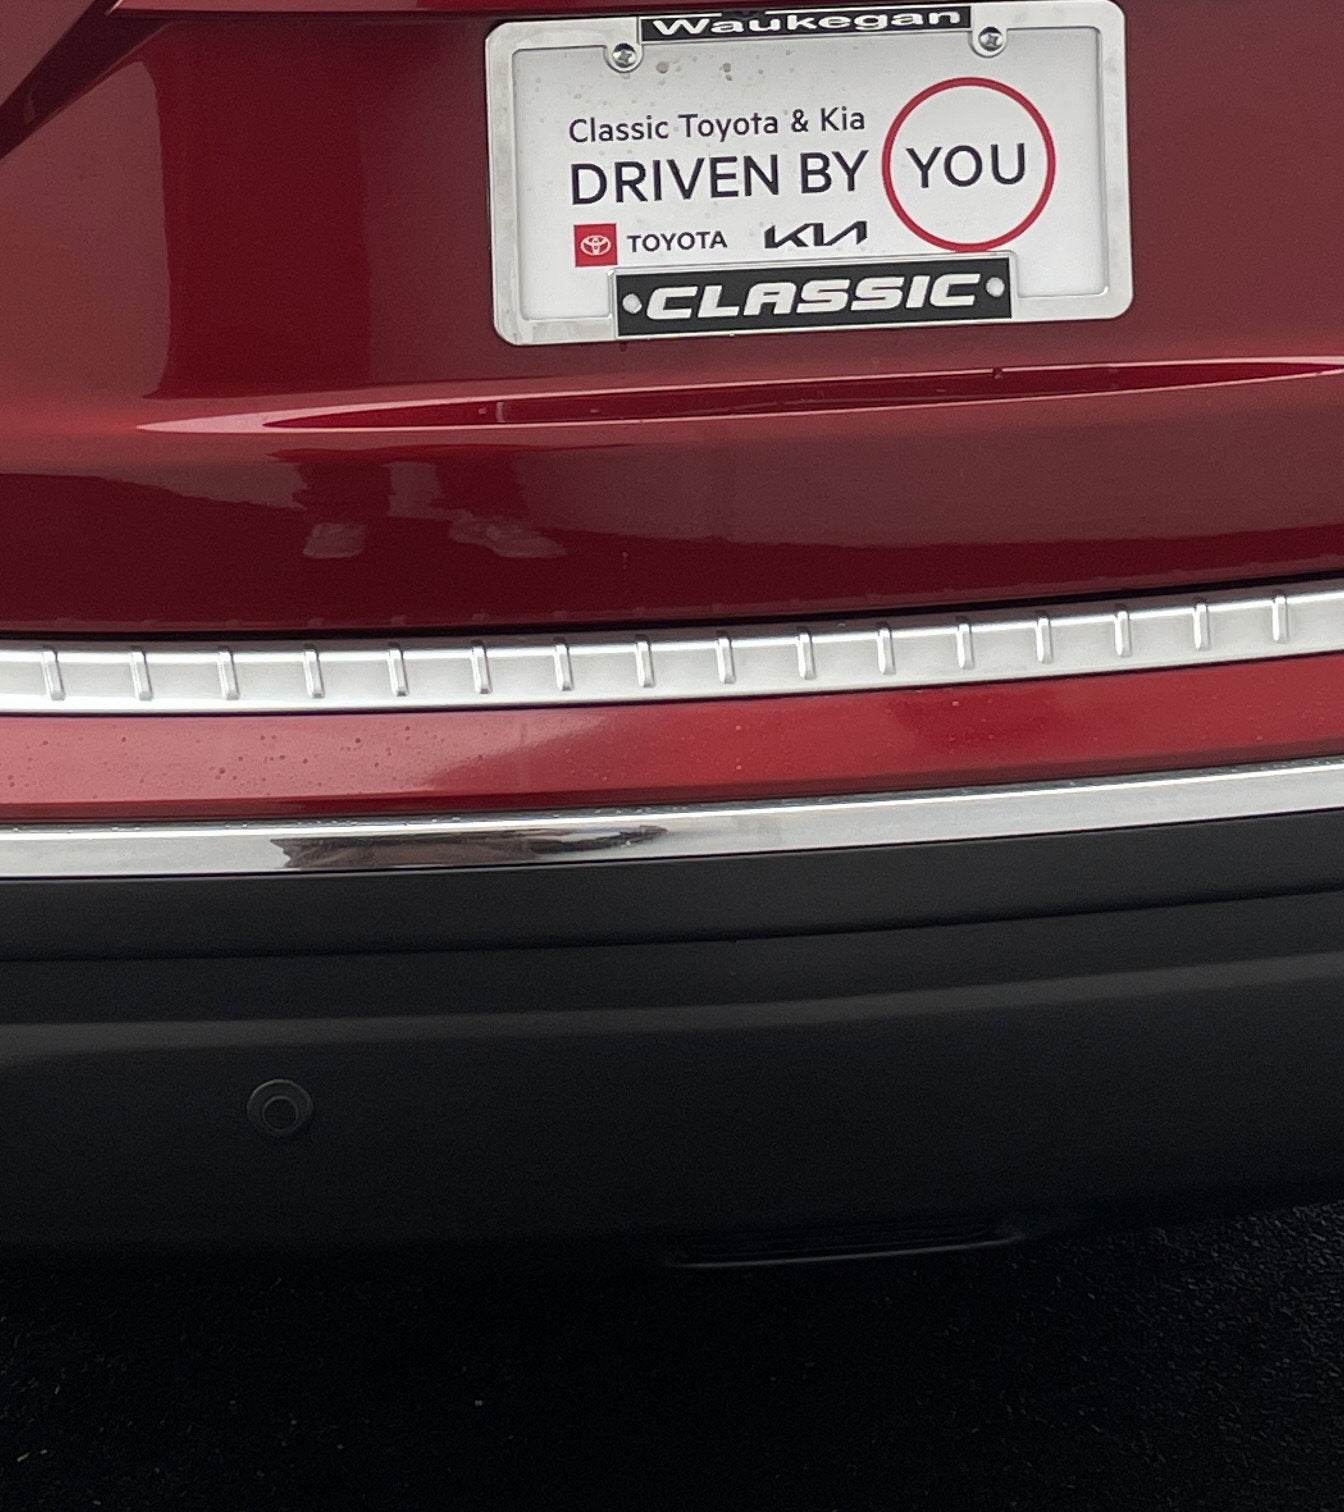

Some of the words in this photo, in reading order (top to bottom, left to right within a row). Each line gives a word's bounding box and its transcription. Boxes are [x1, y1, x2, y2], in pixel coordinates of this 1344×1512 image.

[652, 8, 961, 37] Waukegan
[569, 115, 669, 143] Classic
[678, 112, 779, 142] Toyota
[791, 109, 809, 133] &
[820, 106, 865, 132] Kia
[571, 154, 779, 205] DRIVEN
[800, 150, 869, 194] BY
[905, 143, 1027, 189] YOU
[626, 230, 728, 253] TOYOTA
[764, 220, 868, 249] KIA
[646, 273, 981, 320] CLASSIC
